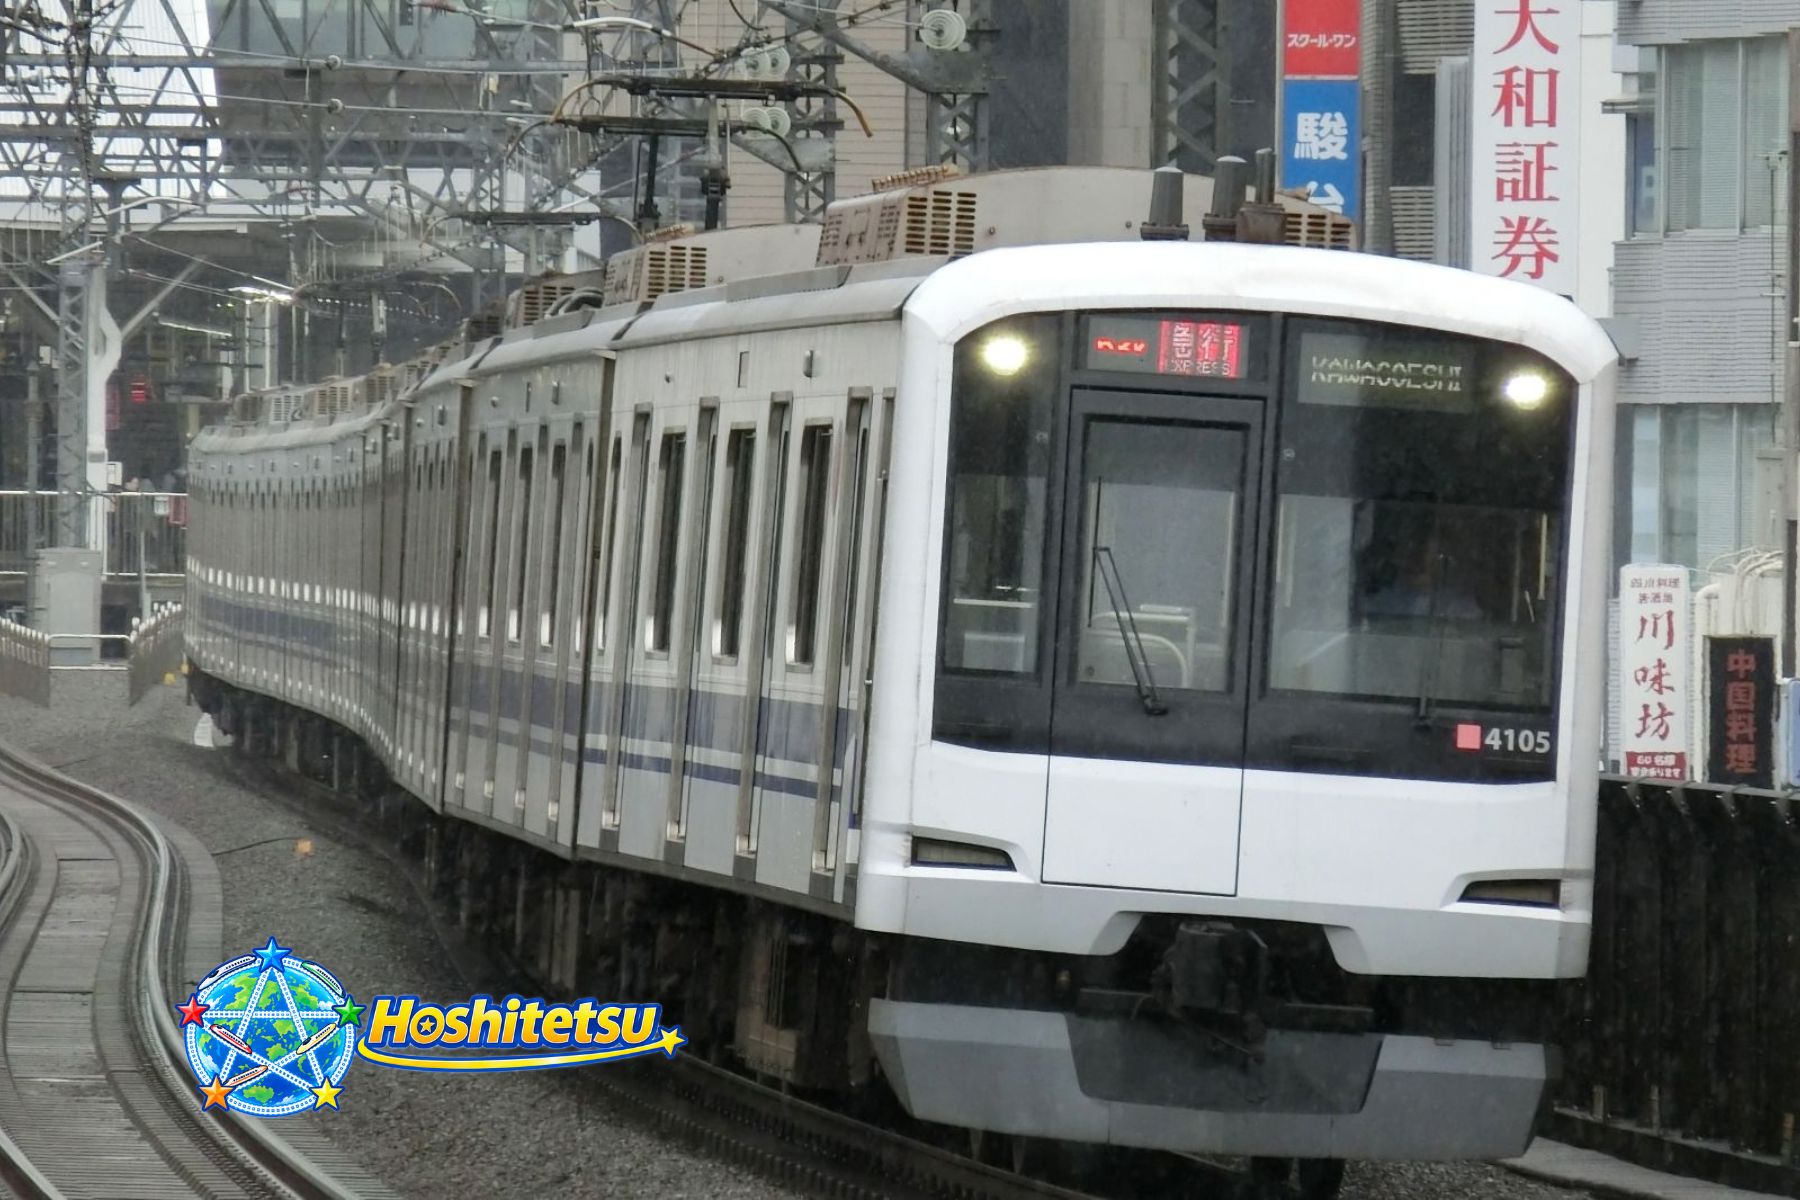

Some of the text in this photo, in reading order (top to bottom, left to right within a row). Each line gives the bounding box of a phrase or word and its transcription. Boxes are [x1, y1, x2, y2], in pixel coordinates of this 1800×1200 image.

[1491, 0, 1560, 280] 大和証券
[1165, 359, 1231, 376] XPRESS
[1172, 325, 1233, 361] 急行
[1634, 609, 1675, 741] 川味坊
[1725, 649, 1757, 774] 中国料理
[1484, 727, 1551, 754] 4105
